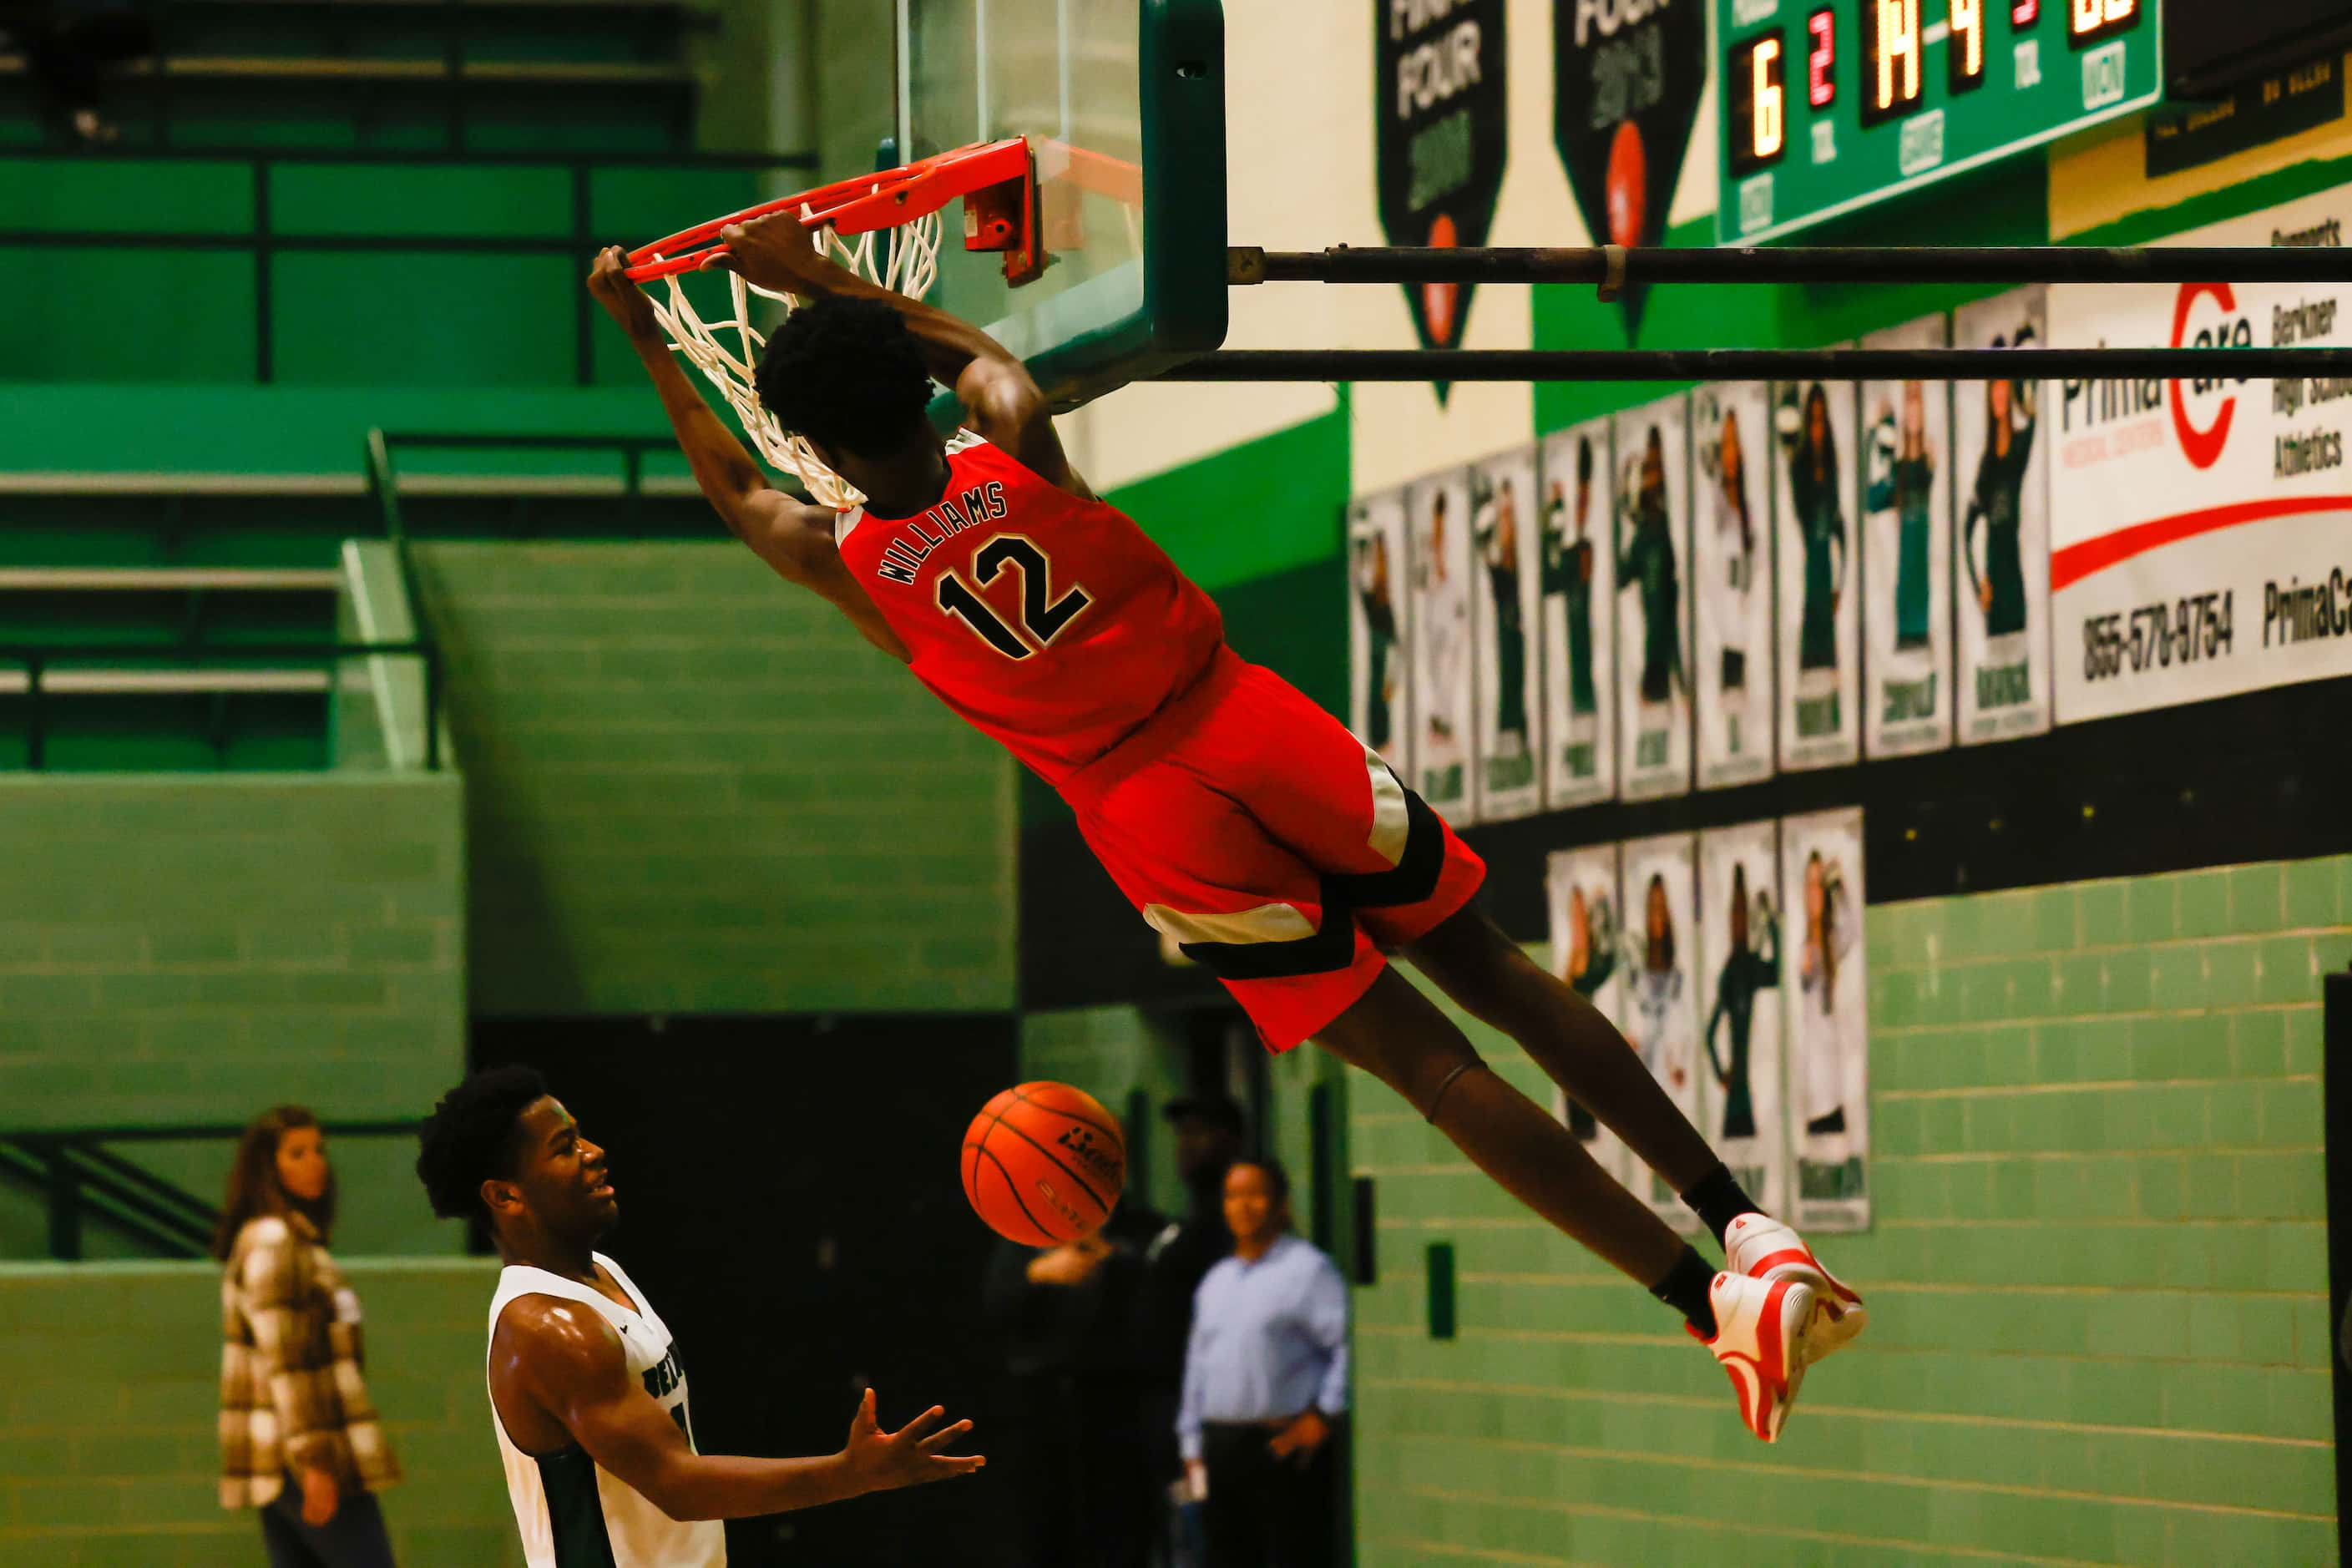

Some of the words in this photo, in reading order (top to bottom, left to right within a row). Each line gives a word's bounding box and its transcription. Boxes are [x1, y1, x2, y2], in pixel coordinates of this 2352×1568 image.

[1397, 21, 1481, 119] FOUR
[1575, 0, 1669, 47] FO
[1808, 11, 1835, 106] 2
[1753, 38, 1783, 157] 6
[878, 481, 1007, 584] WILLIAMS
[934, 532, 1095, 660] 12
